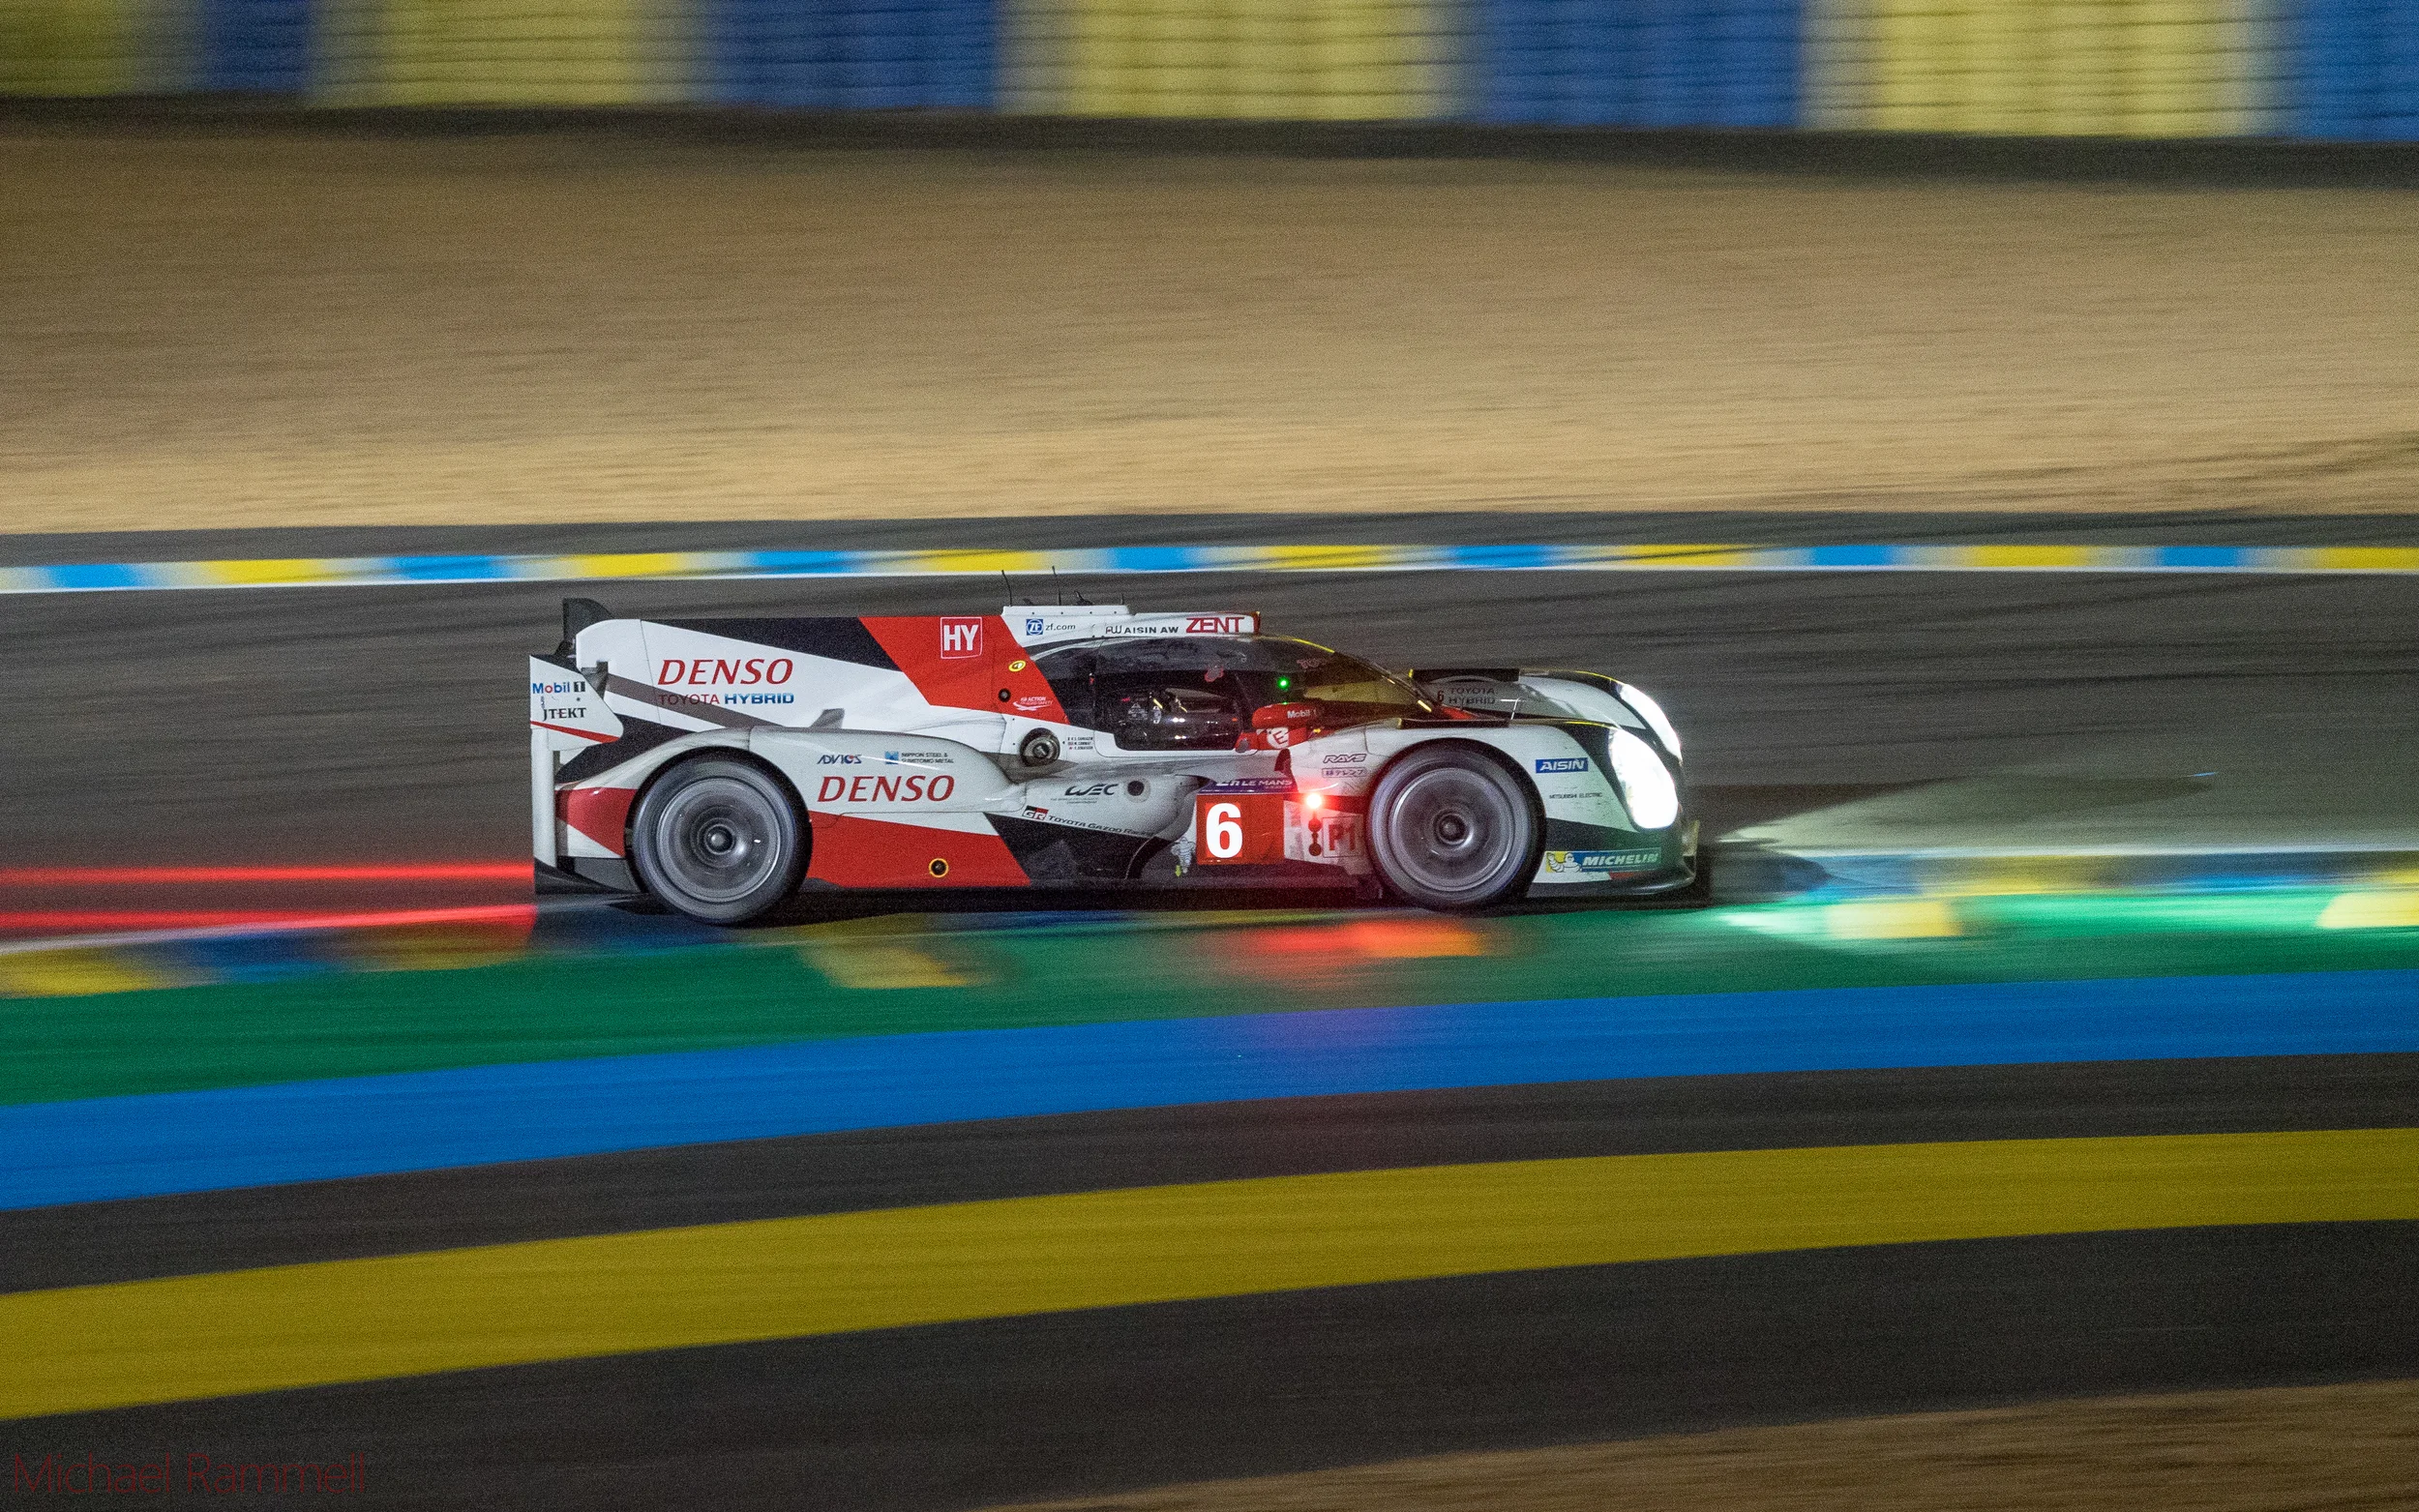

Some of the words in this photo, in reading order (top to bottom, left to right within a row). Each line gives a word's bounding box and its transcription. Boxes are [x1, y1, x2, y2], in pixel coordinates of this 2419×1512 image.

[1030, 623, 1040, 632] ZF
[1186, 617, 1244, 634] ZENT
[943, 624, 979, 651] HY
[658, 658, 793, 685] DENSO
[532, 682, 571, 694] Mobil
[661, 695, 720, 705] TOYOTA
[724, 694, 794, 704] HYBRID
[543, 708, 586, 722] JTEKT
[1323, 754, 1367, 763] RAYS
[1539, 760, 1585, 771] AISIN
[817, 775, 955, 802] DENSO
[1064, 784, 1119, 796] WEC
[1048, 815, 1086, 826] TOYOTA
[1206, 802, 1243, 859] 6
[1582, 852, 1659, 866] MICHELIN
